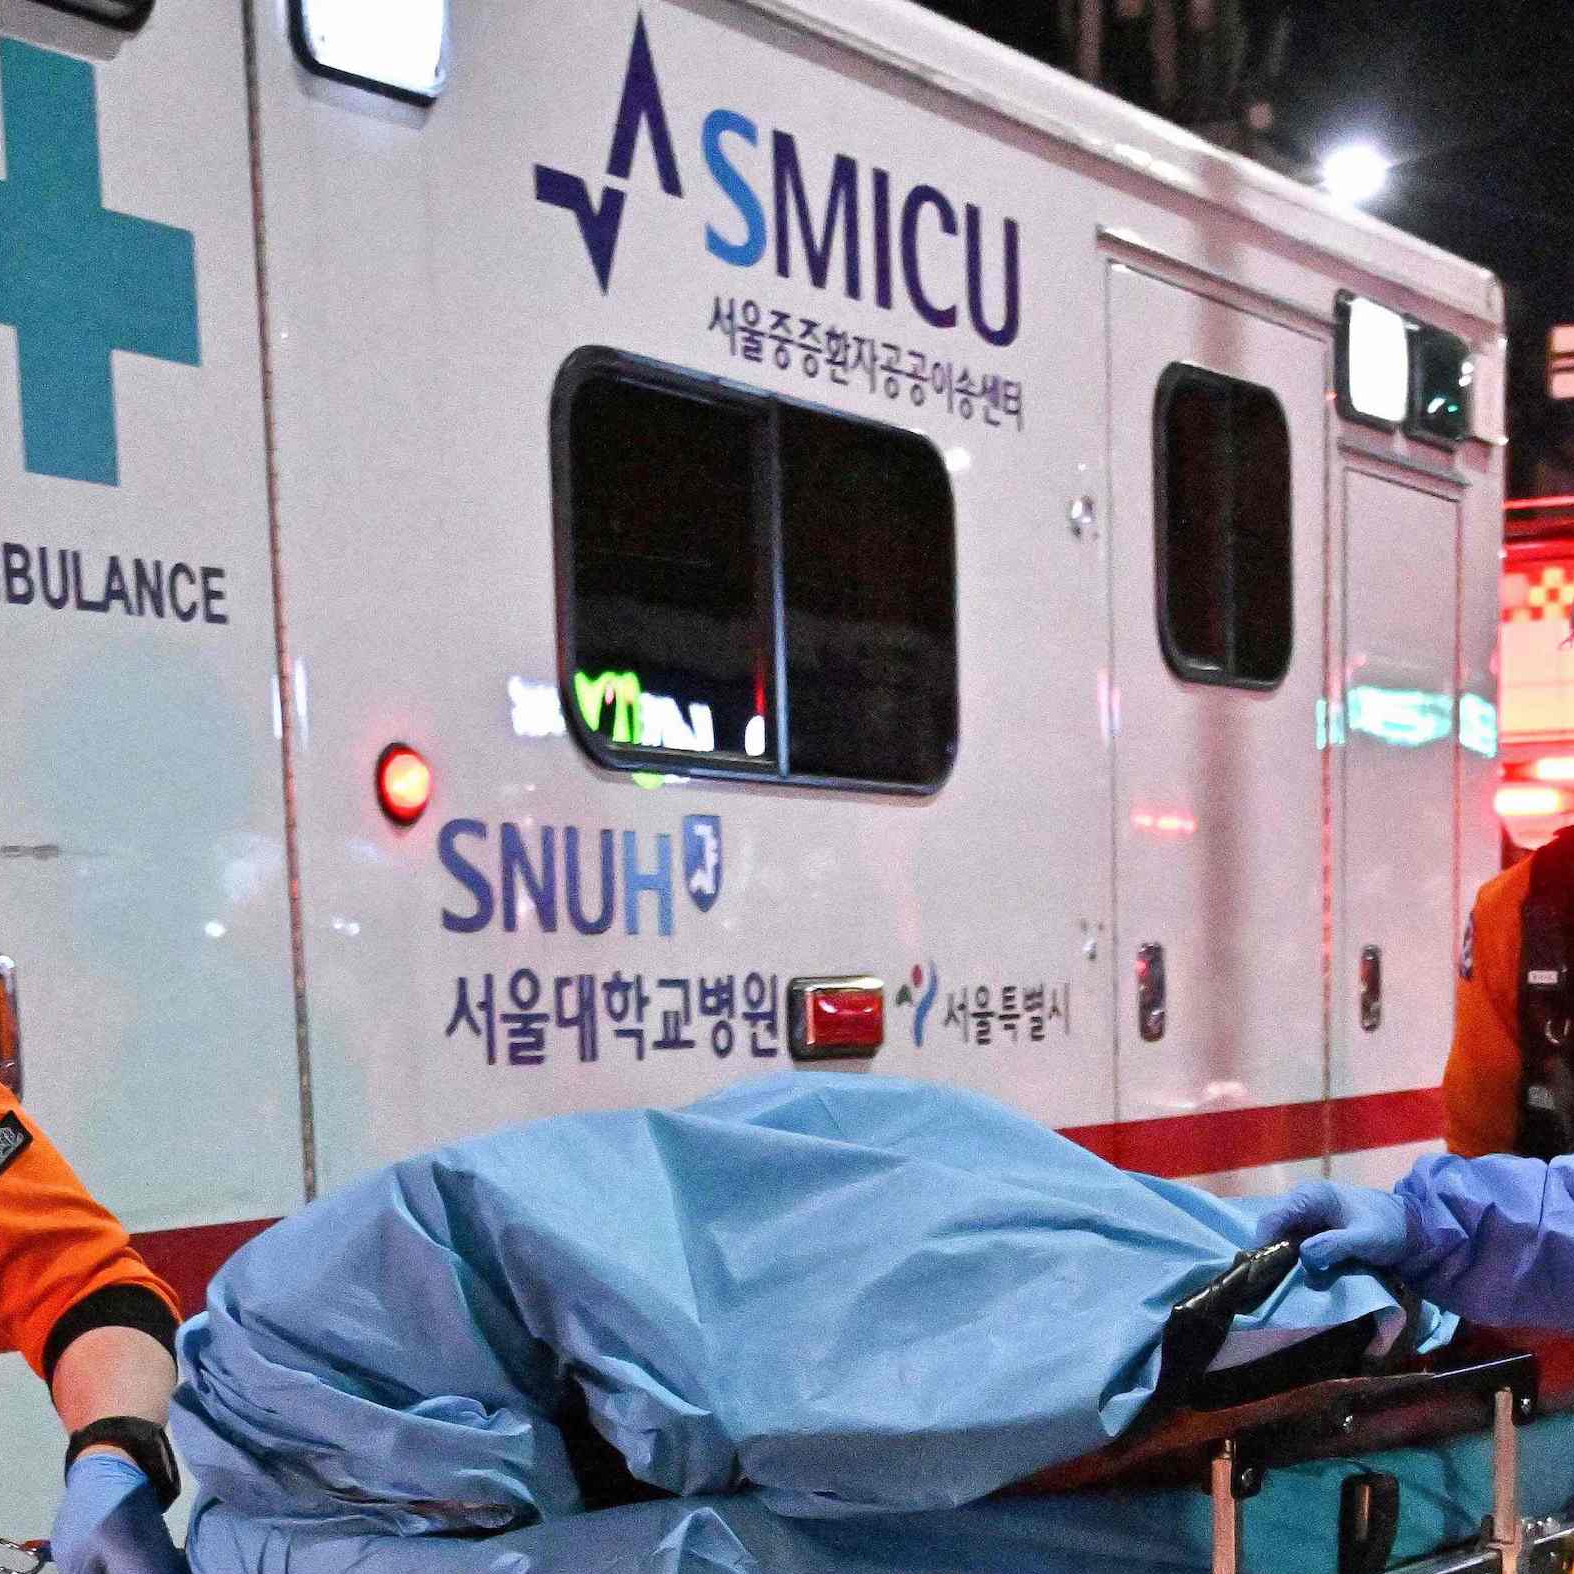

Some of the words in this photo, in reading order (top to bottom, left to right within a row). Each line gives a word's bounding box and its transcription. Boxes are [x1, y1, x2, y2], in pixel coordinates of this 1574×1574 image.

[700, 108, 1019, 347] SMICU
[437, 818, 674, 937] SNUH
[445, 968, 780, 1066] 서울대학교병원
[943, 981, 1072, 1045] 서울특별시
